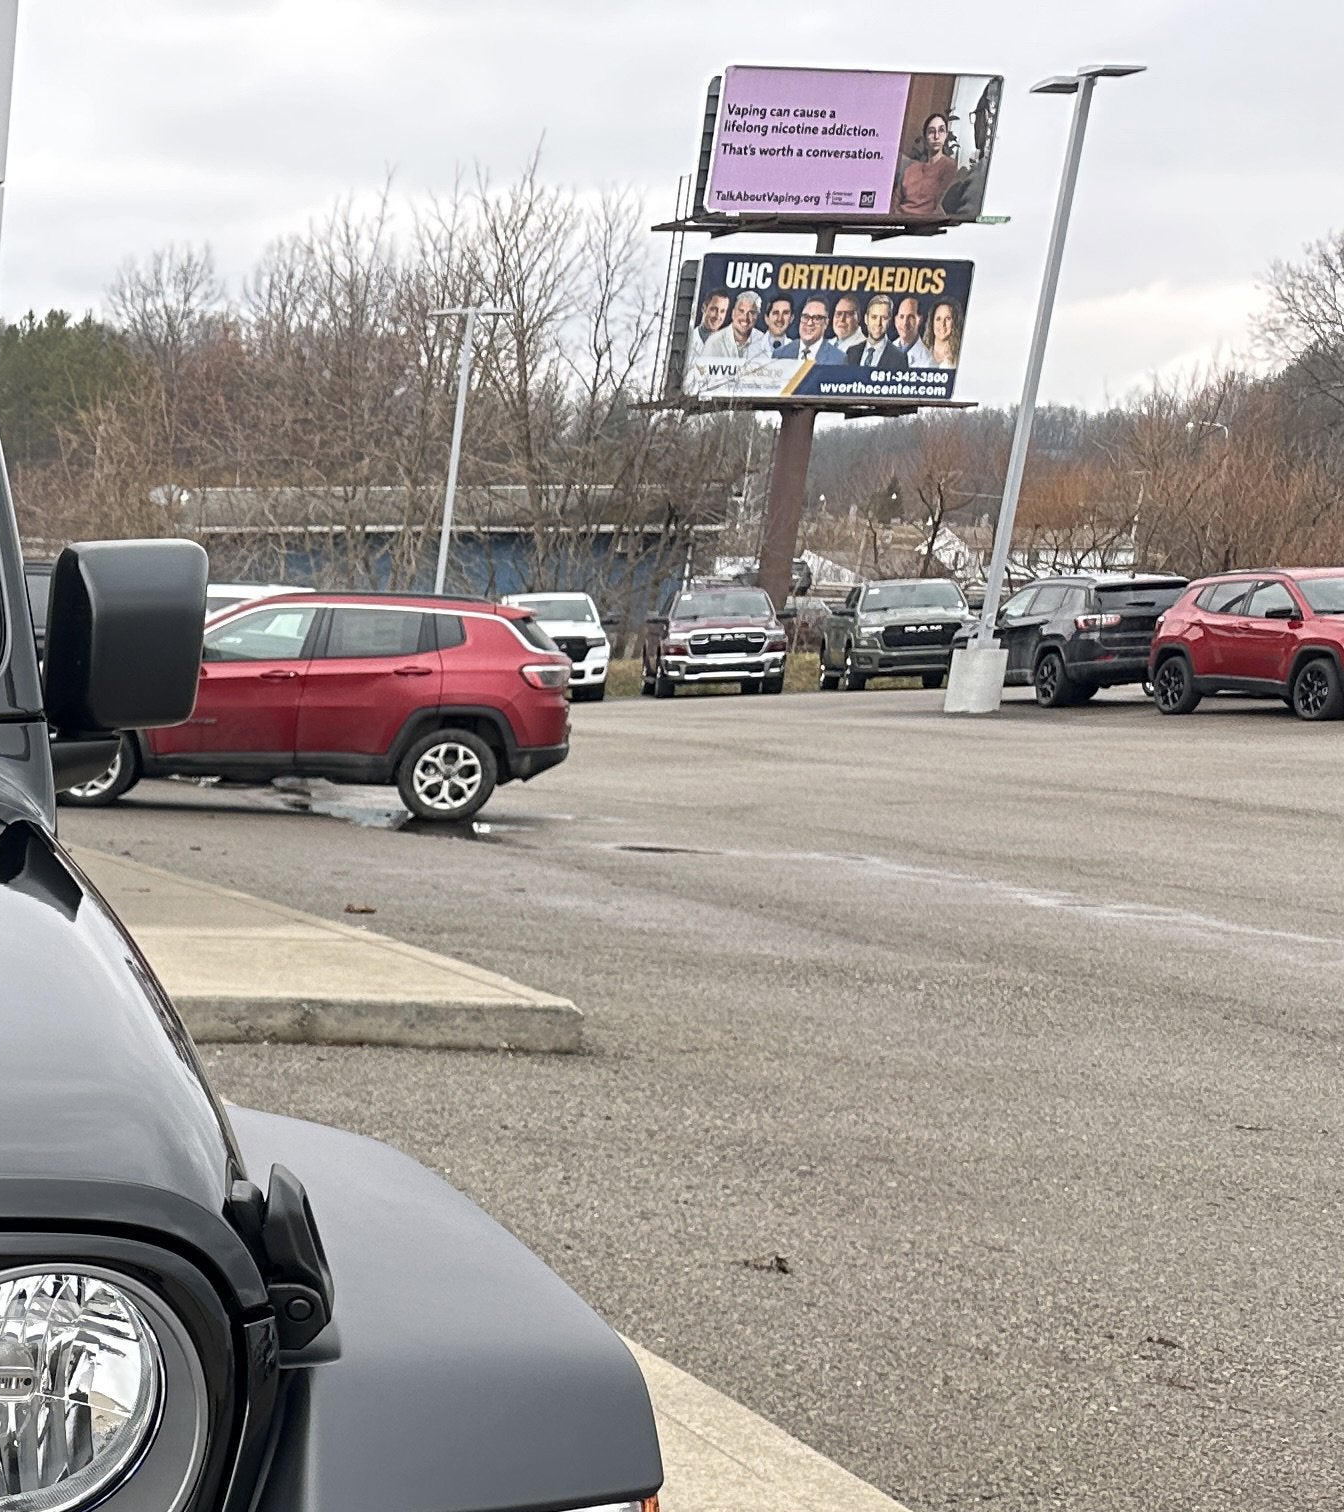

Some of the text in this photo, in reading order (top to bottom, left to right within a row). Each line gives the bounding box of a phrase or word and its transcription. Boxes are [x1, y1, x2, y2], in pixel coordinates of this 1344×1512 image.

[727, 103, 836, 119] Vaping can cause a
[724, 120, 879, 137] lifelong nicotine addiction.
[721, 143, 884, 160] That's worth a conversation.
[715, 190, 821, 205] TalkAboutVaping.org
[725, 261, 946, 294] UHC ORTHOPAEDICS
[708, 364, 737, 376] WVU
[820, 382, 947, 396] wvorthocenter.com
